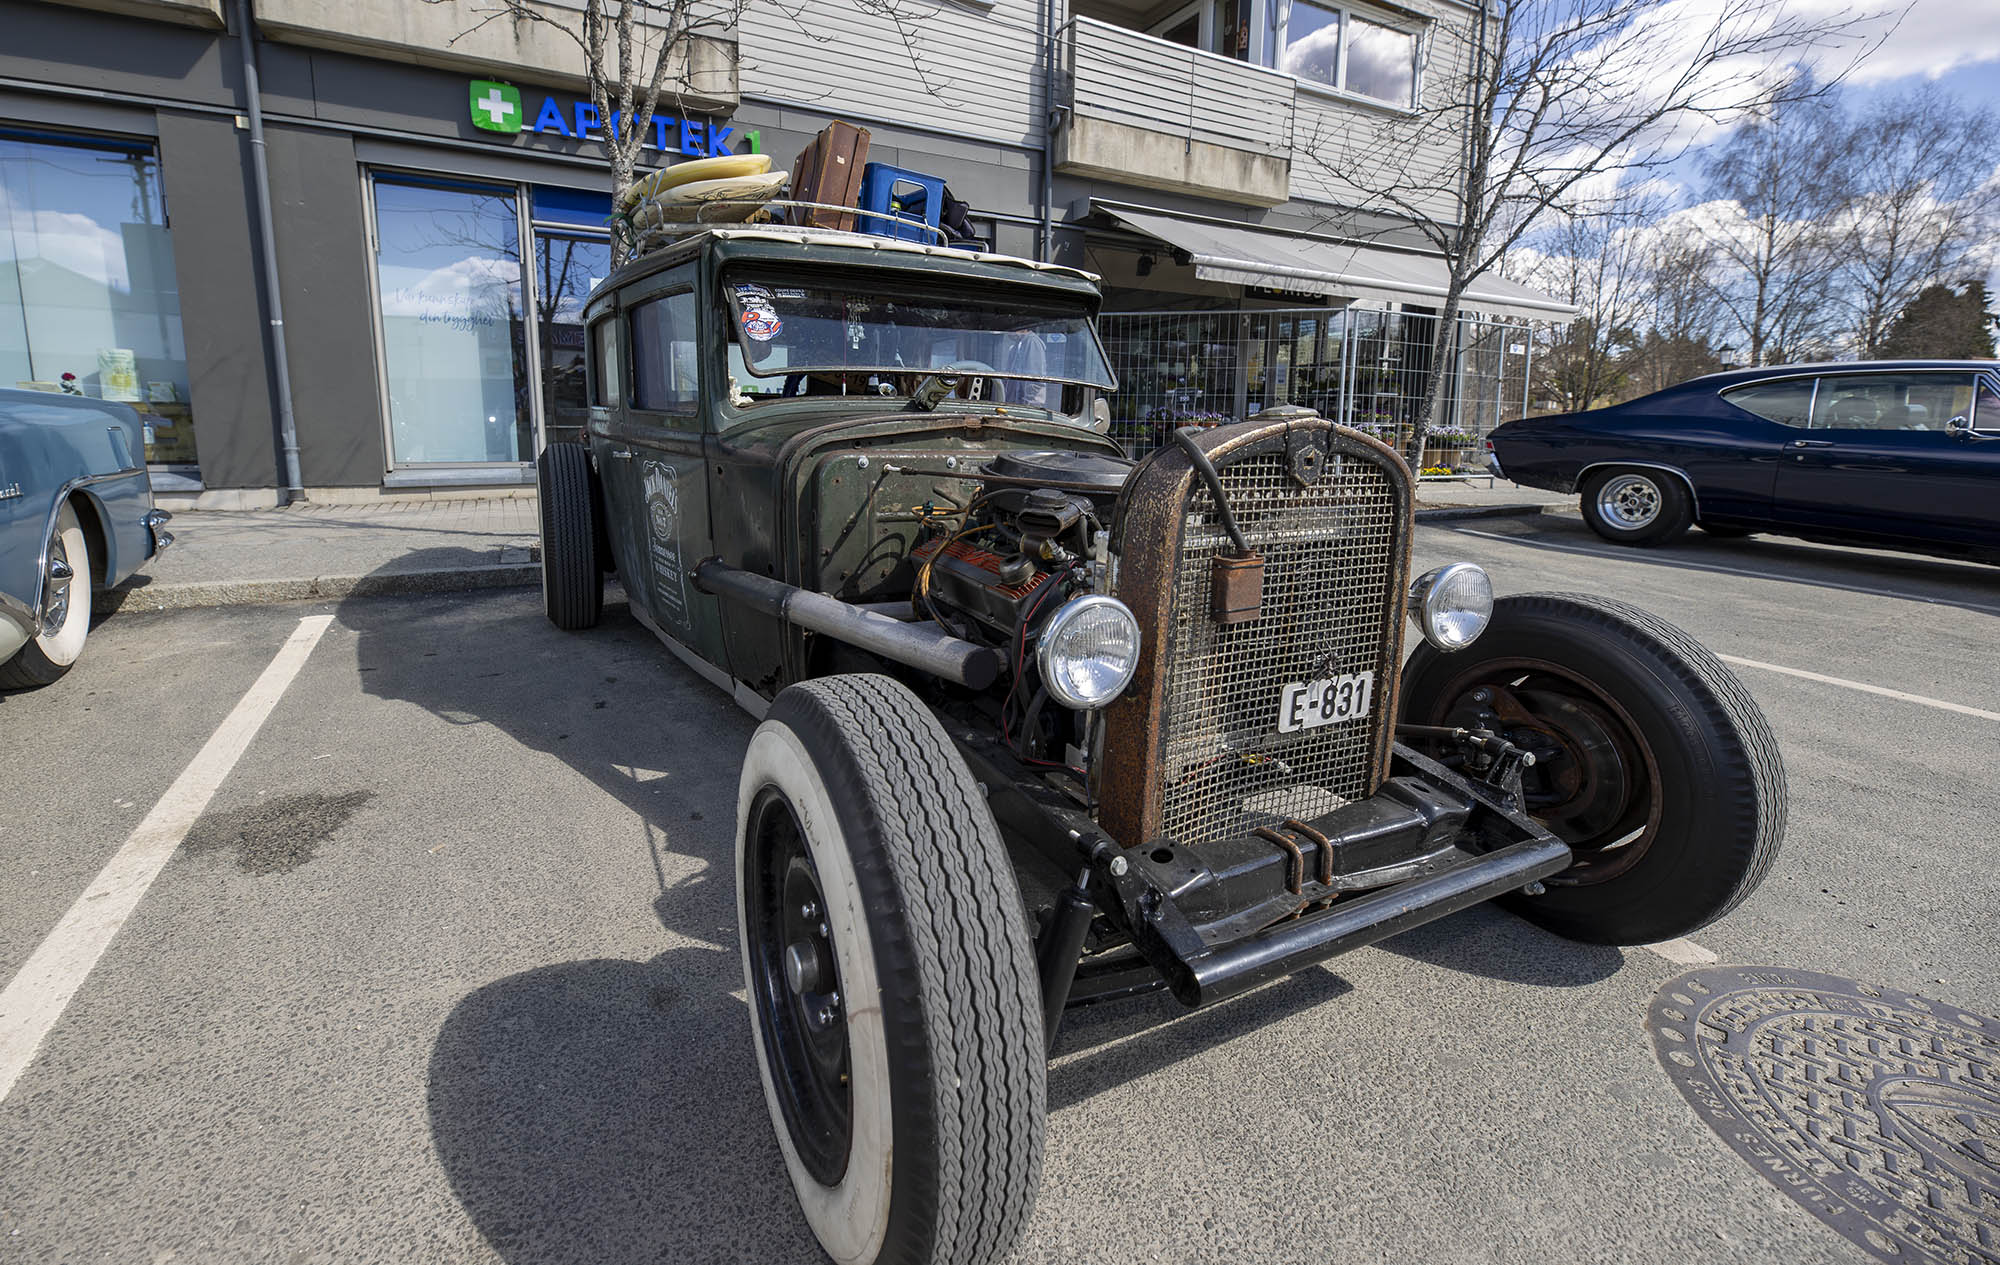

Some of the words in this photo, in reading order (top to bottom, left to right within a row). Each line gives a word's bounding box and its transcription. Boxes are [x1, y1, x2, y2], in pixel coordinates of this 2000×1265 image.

[744, 130, 761, 155] 1
[1289, 679, 1366, 727] E-831
[1735, 1132, 1846, 1216] FURNES
